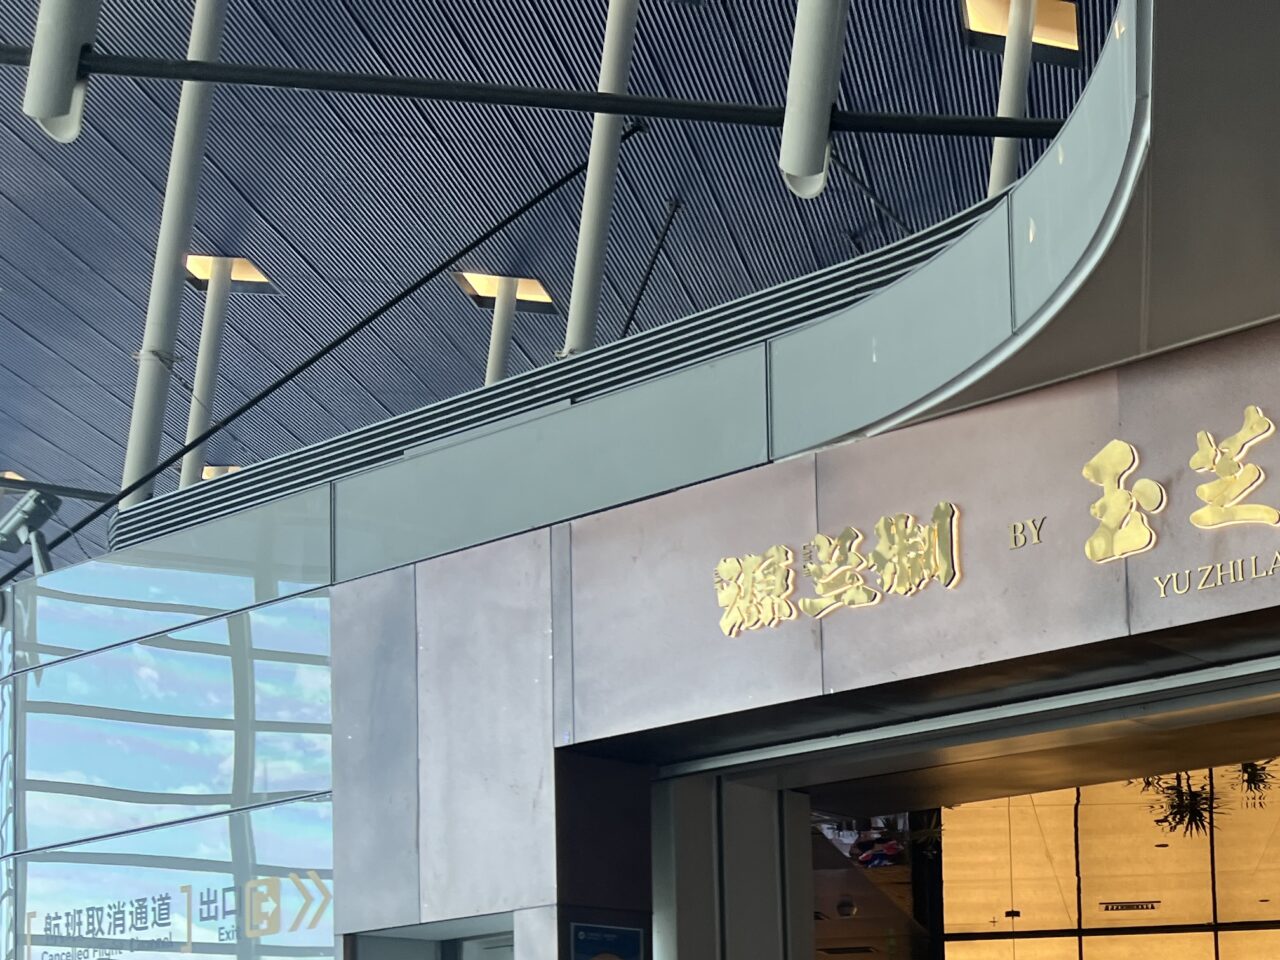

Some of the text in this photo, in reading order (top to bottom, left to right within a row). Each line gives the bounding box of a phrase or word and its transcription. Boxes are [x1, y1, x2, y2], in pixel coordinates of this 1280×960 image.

[1008, 516, 1047, 550] BY
[1154, 570, 1190, 598] YU
[1198, 560, 1244, 591] ZHI
[44, 887, 239, 937] 航班取消通道 出口
